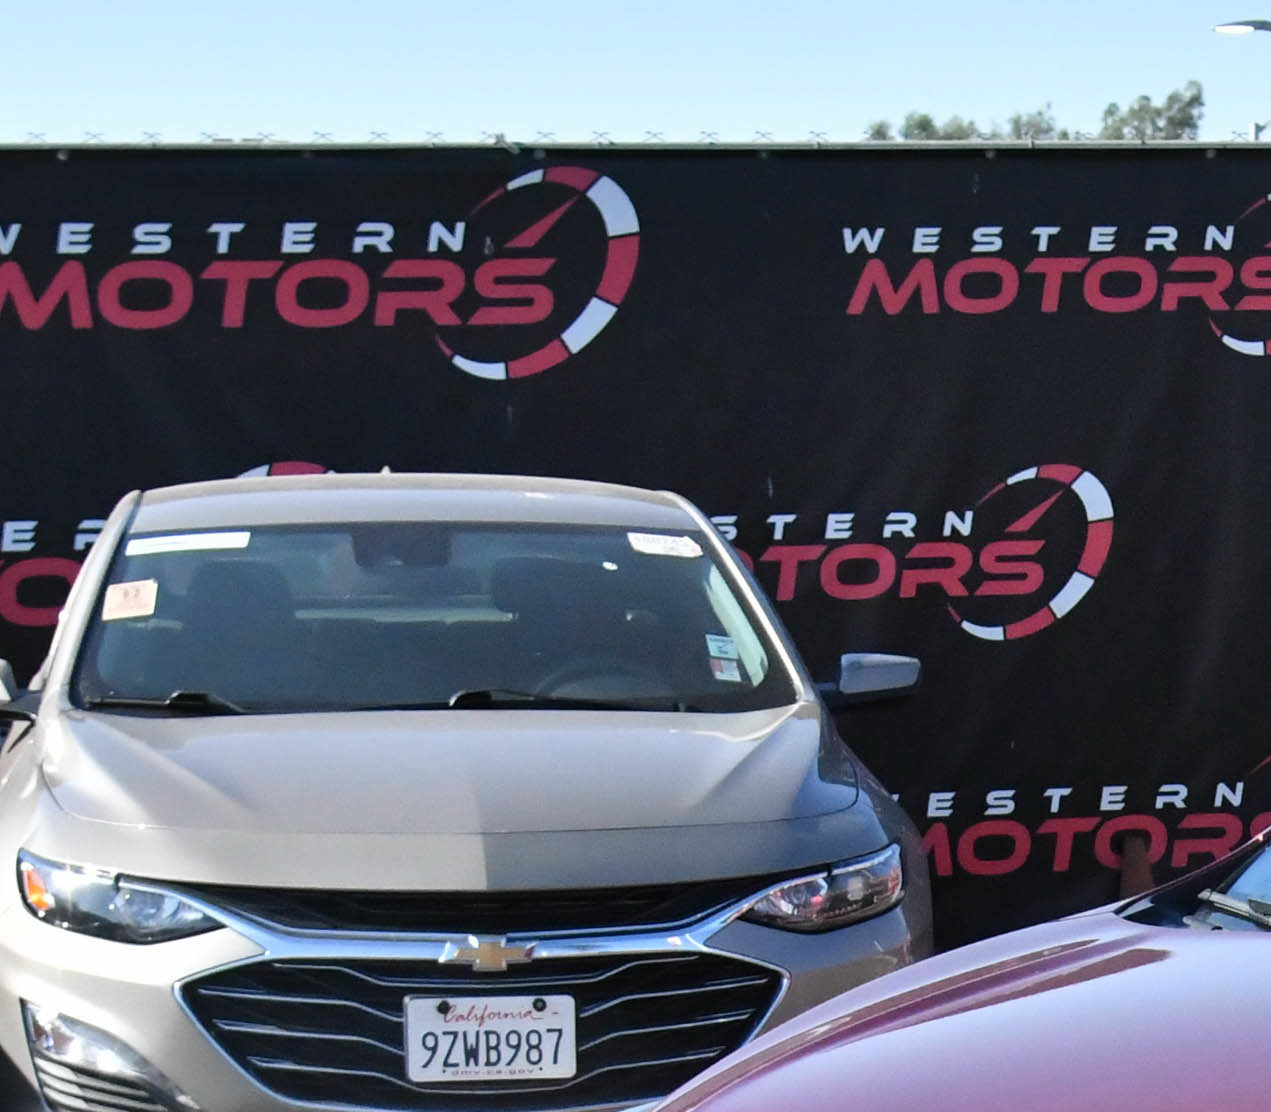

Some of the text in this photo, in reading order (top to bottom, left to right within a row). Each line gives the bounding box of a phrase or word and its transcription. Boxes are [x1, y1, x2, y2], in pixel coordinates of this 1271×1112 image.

[842, 225, 1236, 254] WESTERN
[0, 257, 557, 330] MOTORS
[710, 510, 975, 541] STERN
[735, 540, 1047, 601] TORS
[891, 781, 1244, 818] ESTERN
[443, 1004, 542, 1028] California
[421, 1028, 563, 1069] 9ZWB987
